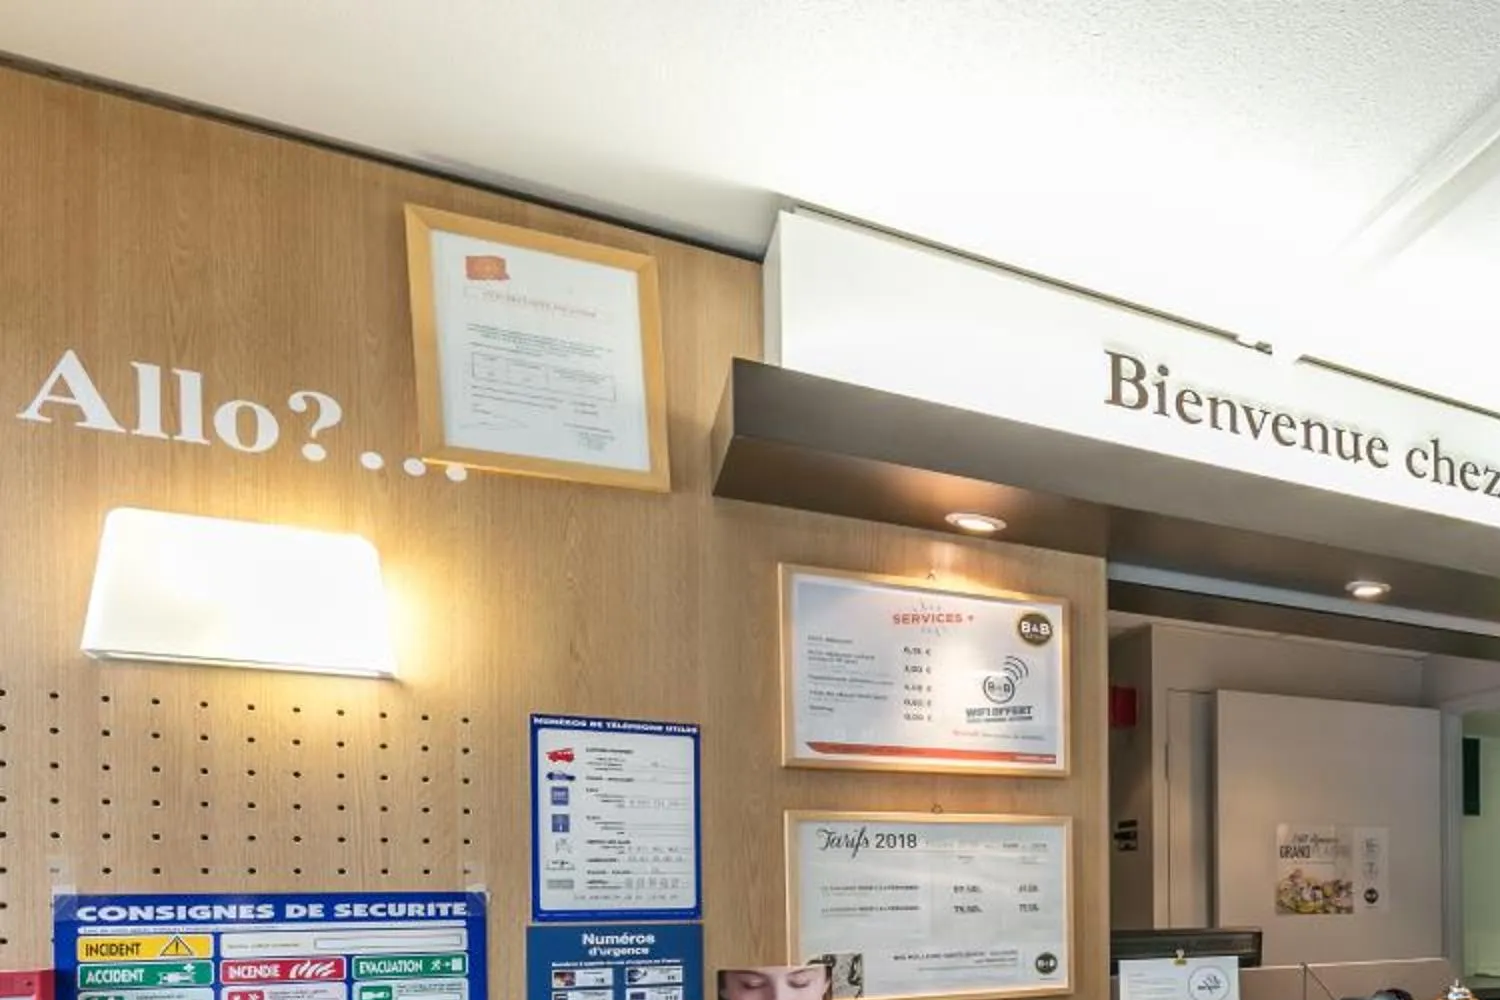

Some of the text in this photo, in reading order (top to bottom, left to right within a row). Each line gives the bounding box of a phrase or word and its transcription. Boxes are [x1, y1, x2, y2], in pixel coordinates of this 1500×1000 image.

[1103, 349, 1390, 470] Bienvenue
[893, 613, 963, 625] SERVICES
[816, 826, 918, 859] Tarifs 2018
[76, 902, 468, 922] CONSIGNES DE SECURITE
[581, 933, 656, 946] Numéros
[85, 943, 142, 957] INCIDENT
[588, 946, 650, 957] d'urgence
[227, 964, 281, 979] INCENDIE
[358, 959, 423, 976] EVACUATION
[86, 969, 145, 984] ACCIDENT
